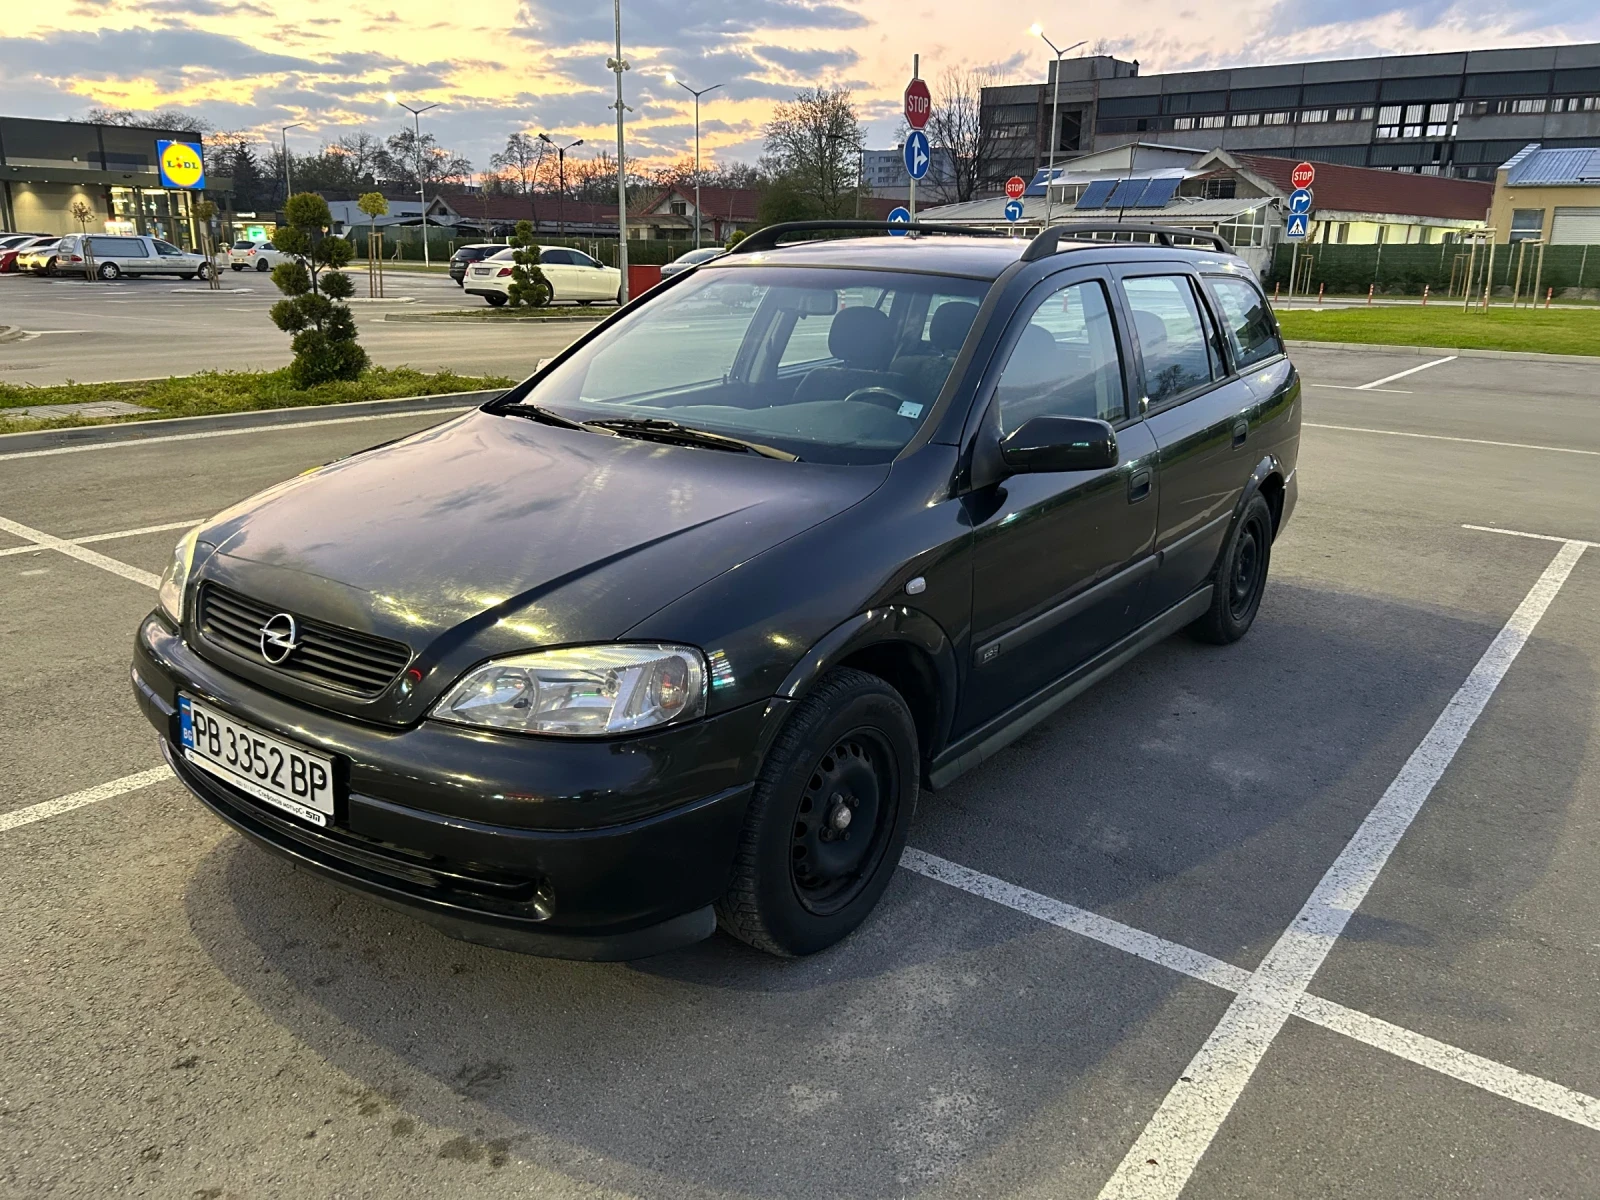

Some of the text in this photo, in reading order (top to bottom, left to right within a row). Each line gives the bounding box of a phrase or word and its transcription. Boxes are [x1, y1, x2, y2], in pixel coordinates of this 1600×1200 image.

[908, 95, 929, 114] STOP
[1294, 171, 1312, 181] STOP
[1007, 183, 1023, 192] STOP
[183, 727, 193, 742] BG
[193, 709, 221, 757] PB
[226, 726, 286, 790] 3352
[290, 753, 327, 802] BP
